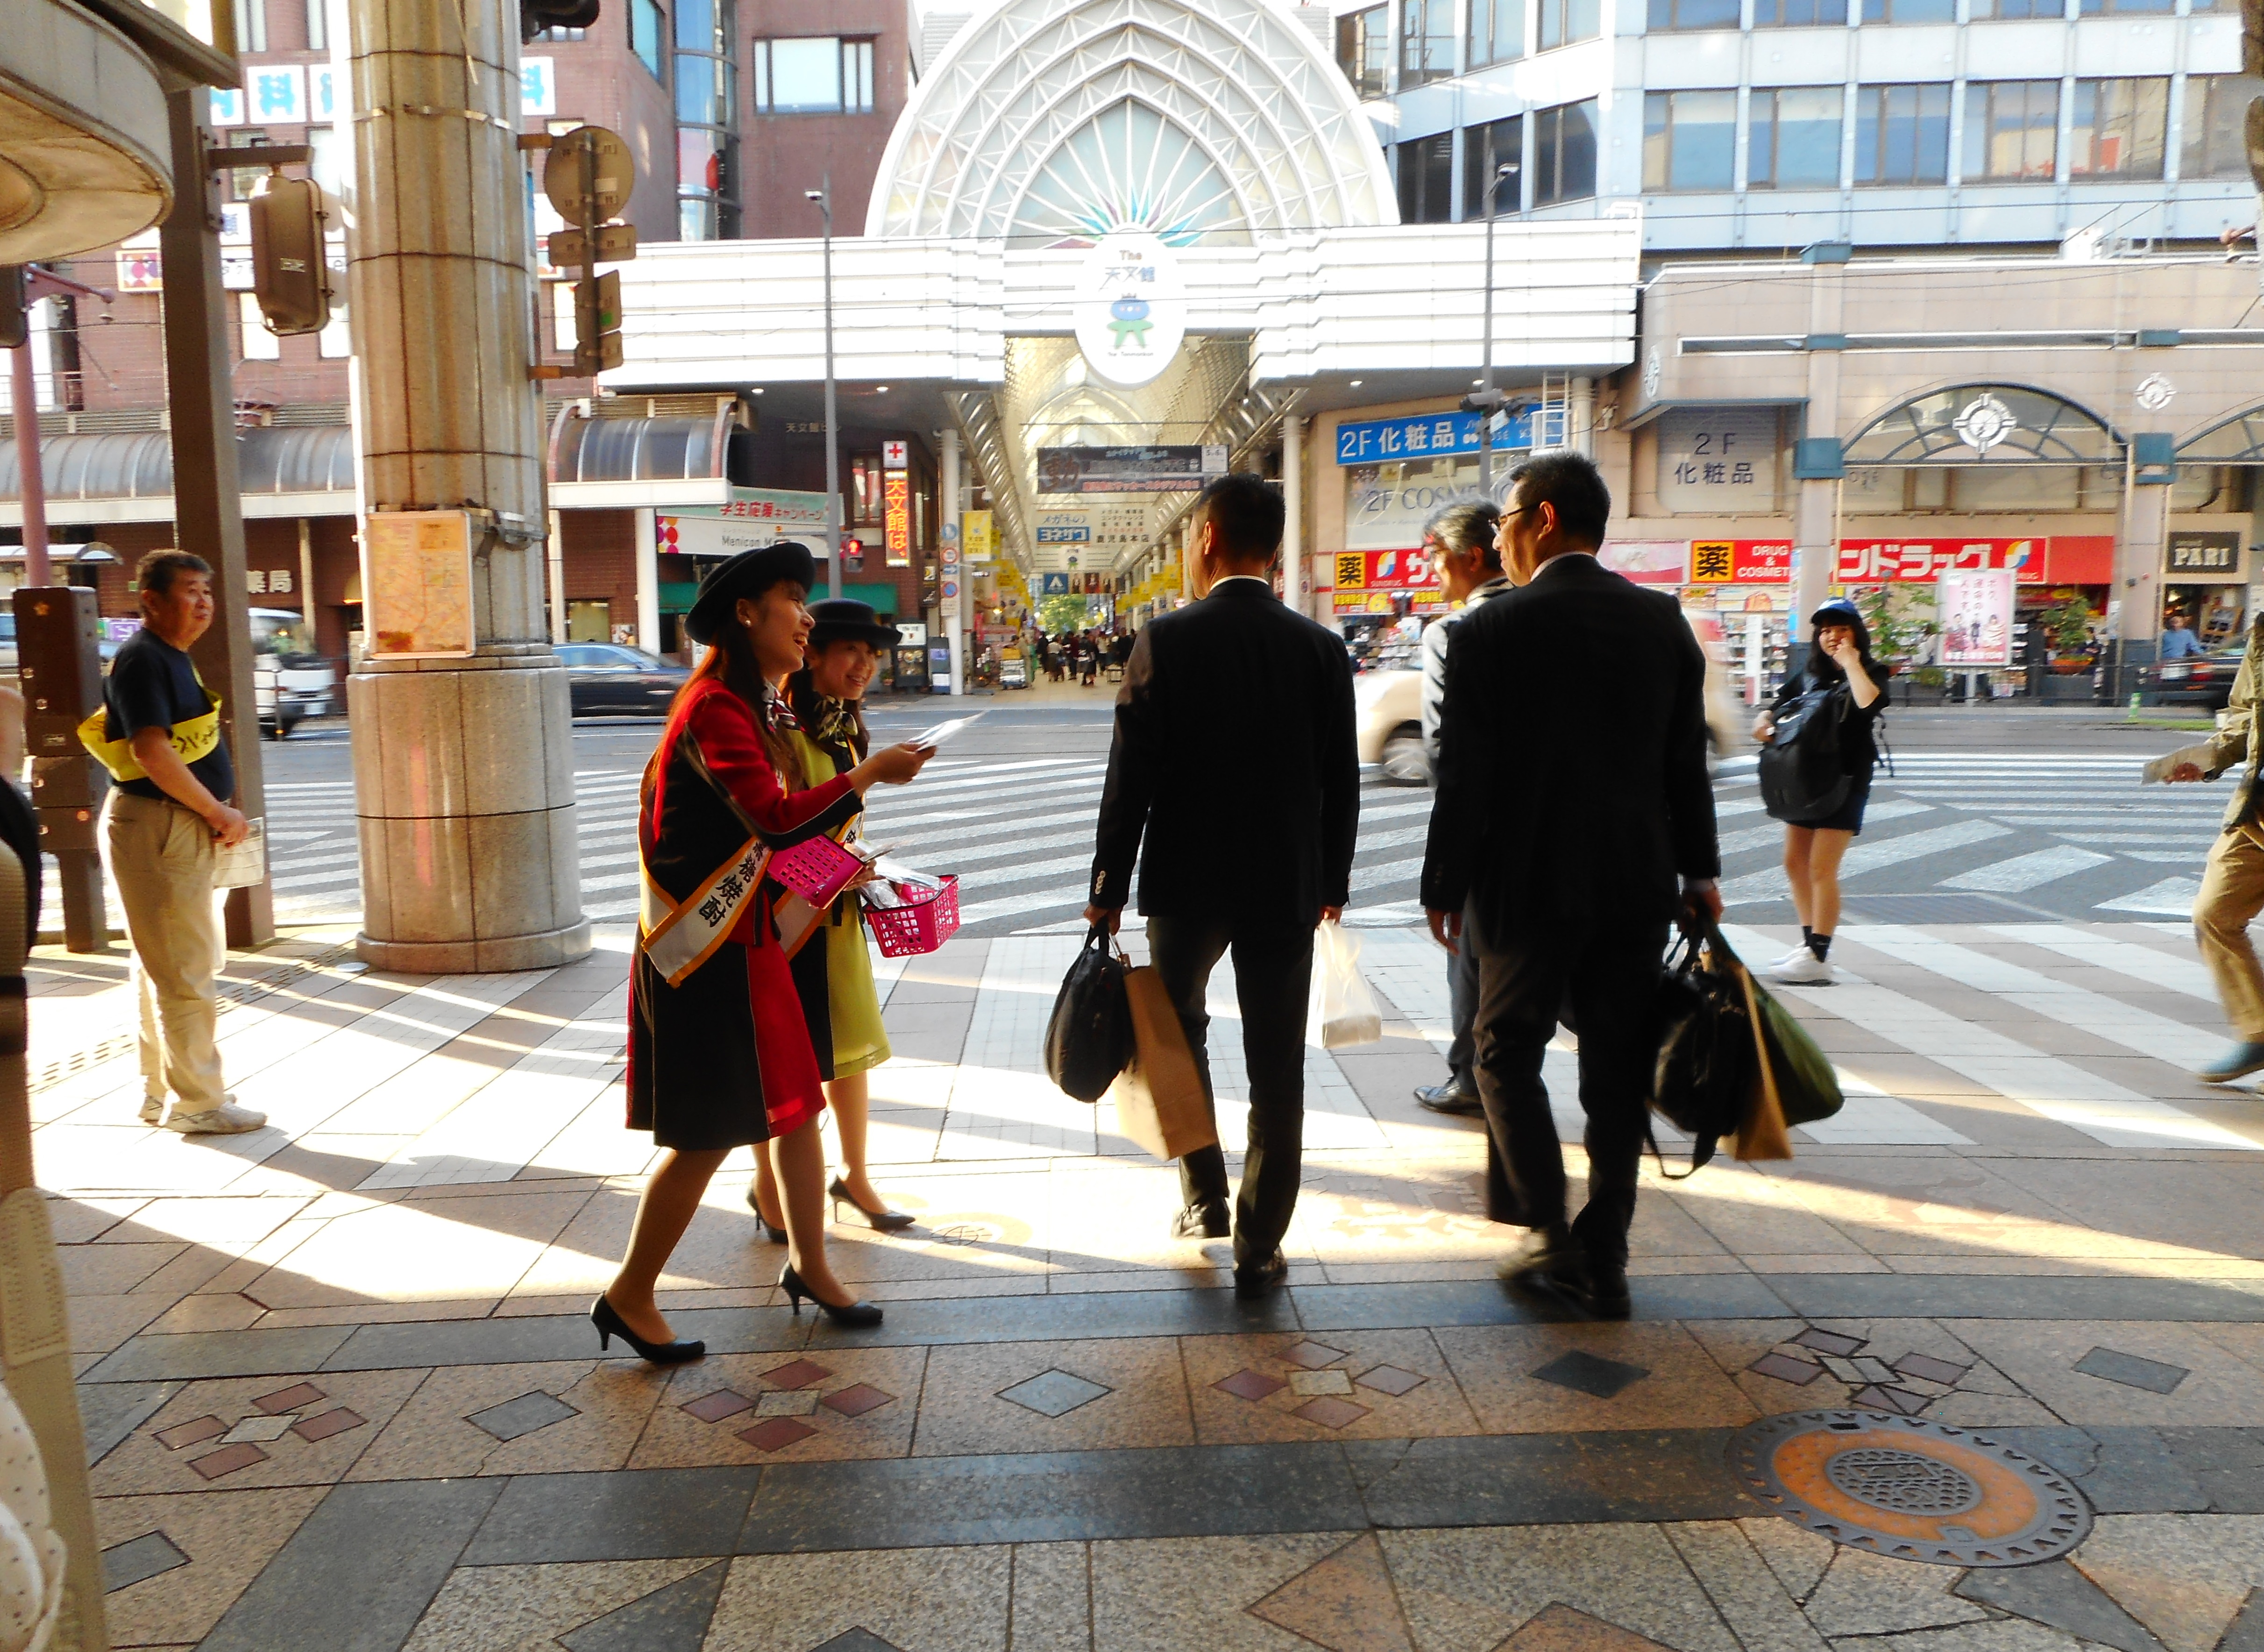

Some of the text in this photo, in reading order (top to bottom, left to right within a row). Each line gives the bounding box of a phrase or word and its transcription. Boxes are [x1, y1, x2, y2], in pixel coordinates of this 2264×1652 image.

[1119, 250, 1143, 261] The
[1099, 266, 1155, 291] 天文館
[1341, 429, 1372, 458] 2F
[1378, 420, 1455, 454] 化粧品
[1694, 432, 1736, 454] 2F
[1674, 462, 1754, 484] 化粧品
[720, 499, 830, 521] 学生応援キャンペーン
[1752, 545, 1789, 556] DRUG
[1765, 556, 1776, 566] &
[1839, 544, 1992, 577] ンドラッグ
[2174, 547, 2230, 567] PARI
[1339, 555, 1362, 584] 薬
[1696, 546, 1730, 578] 薬
[1737, 567, 1791, 578] COSMET
[246, 569, 292, 594] 薬局
